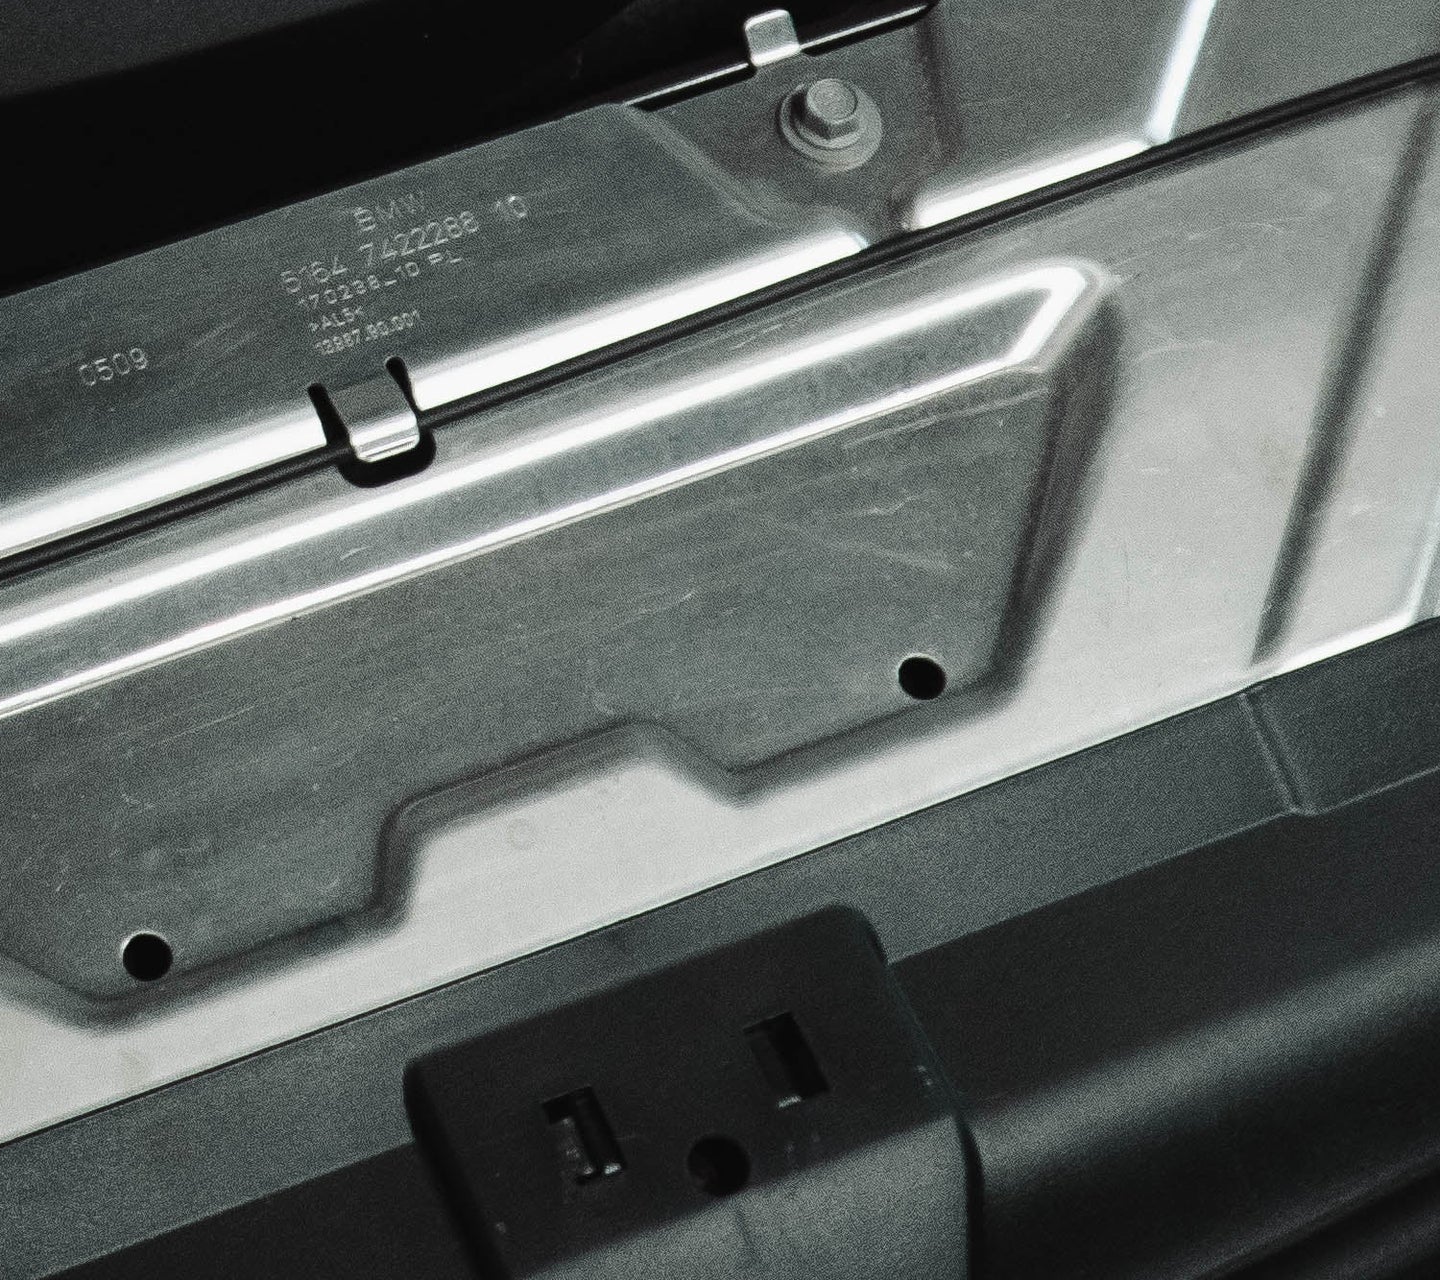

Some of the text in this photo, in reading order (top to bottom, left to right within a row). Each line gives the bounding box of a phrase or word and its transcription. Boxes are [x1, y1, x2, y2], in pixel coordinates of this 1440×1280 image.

[351, 190, 427, 232] BMW
[279, 255, 349, 296] 5164
[356, 209, 480, 268] 7422288
